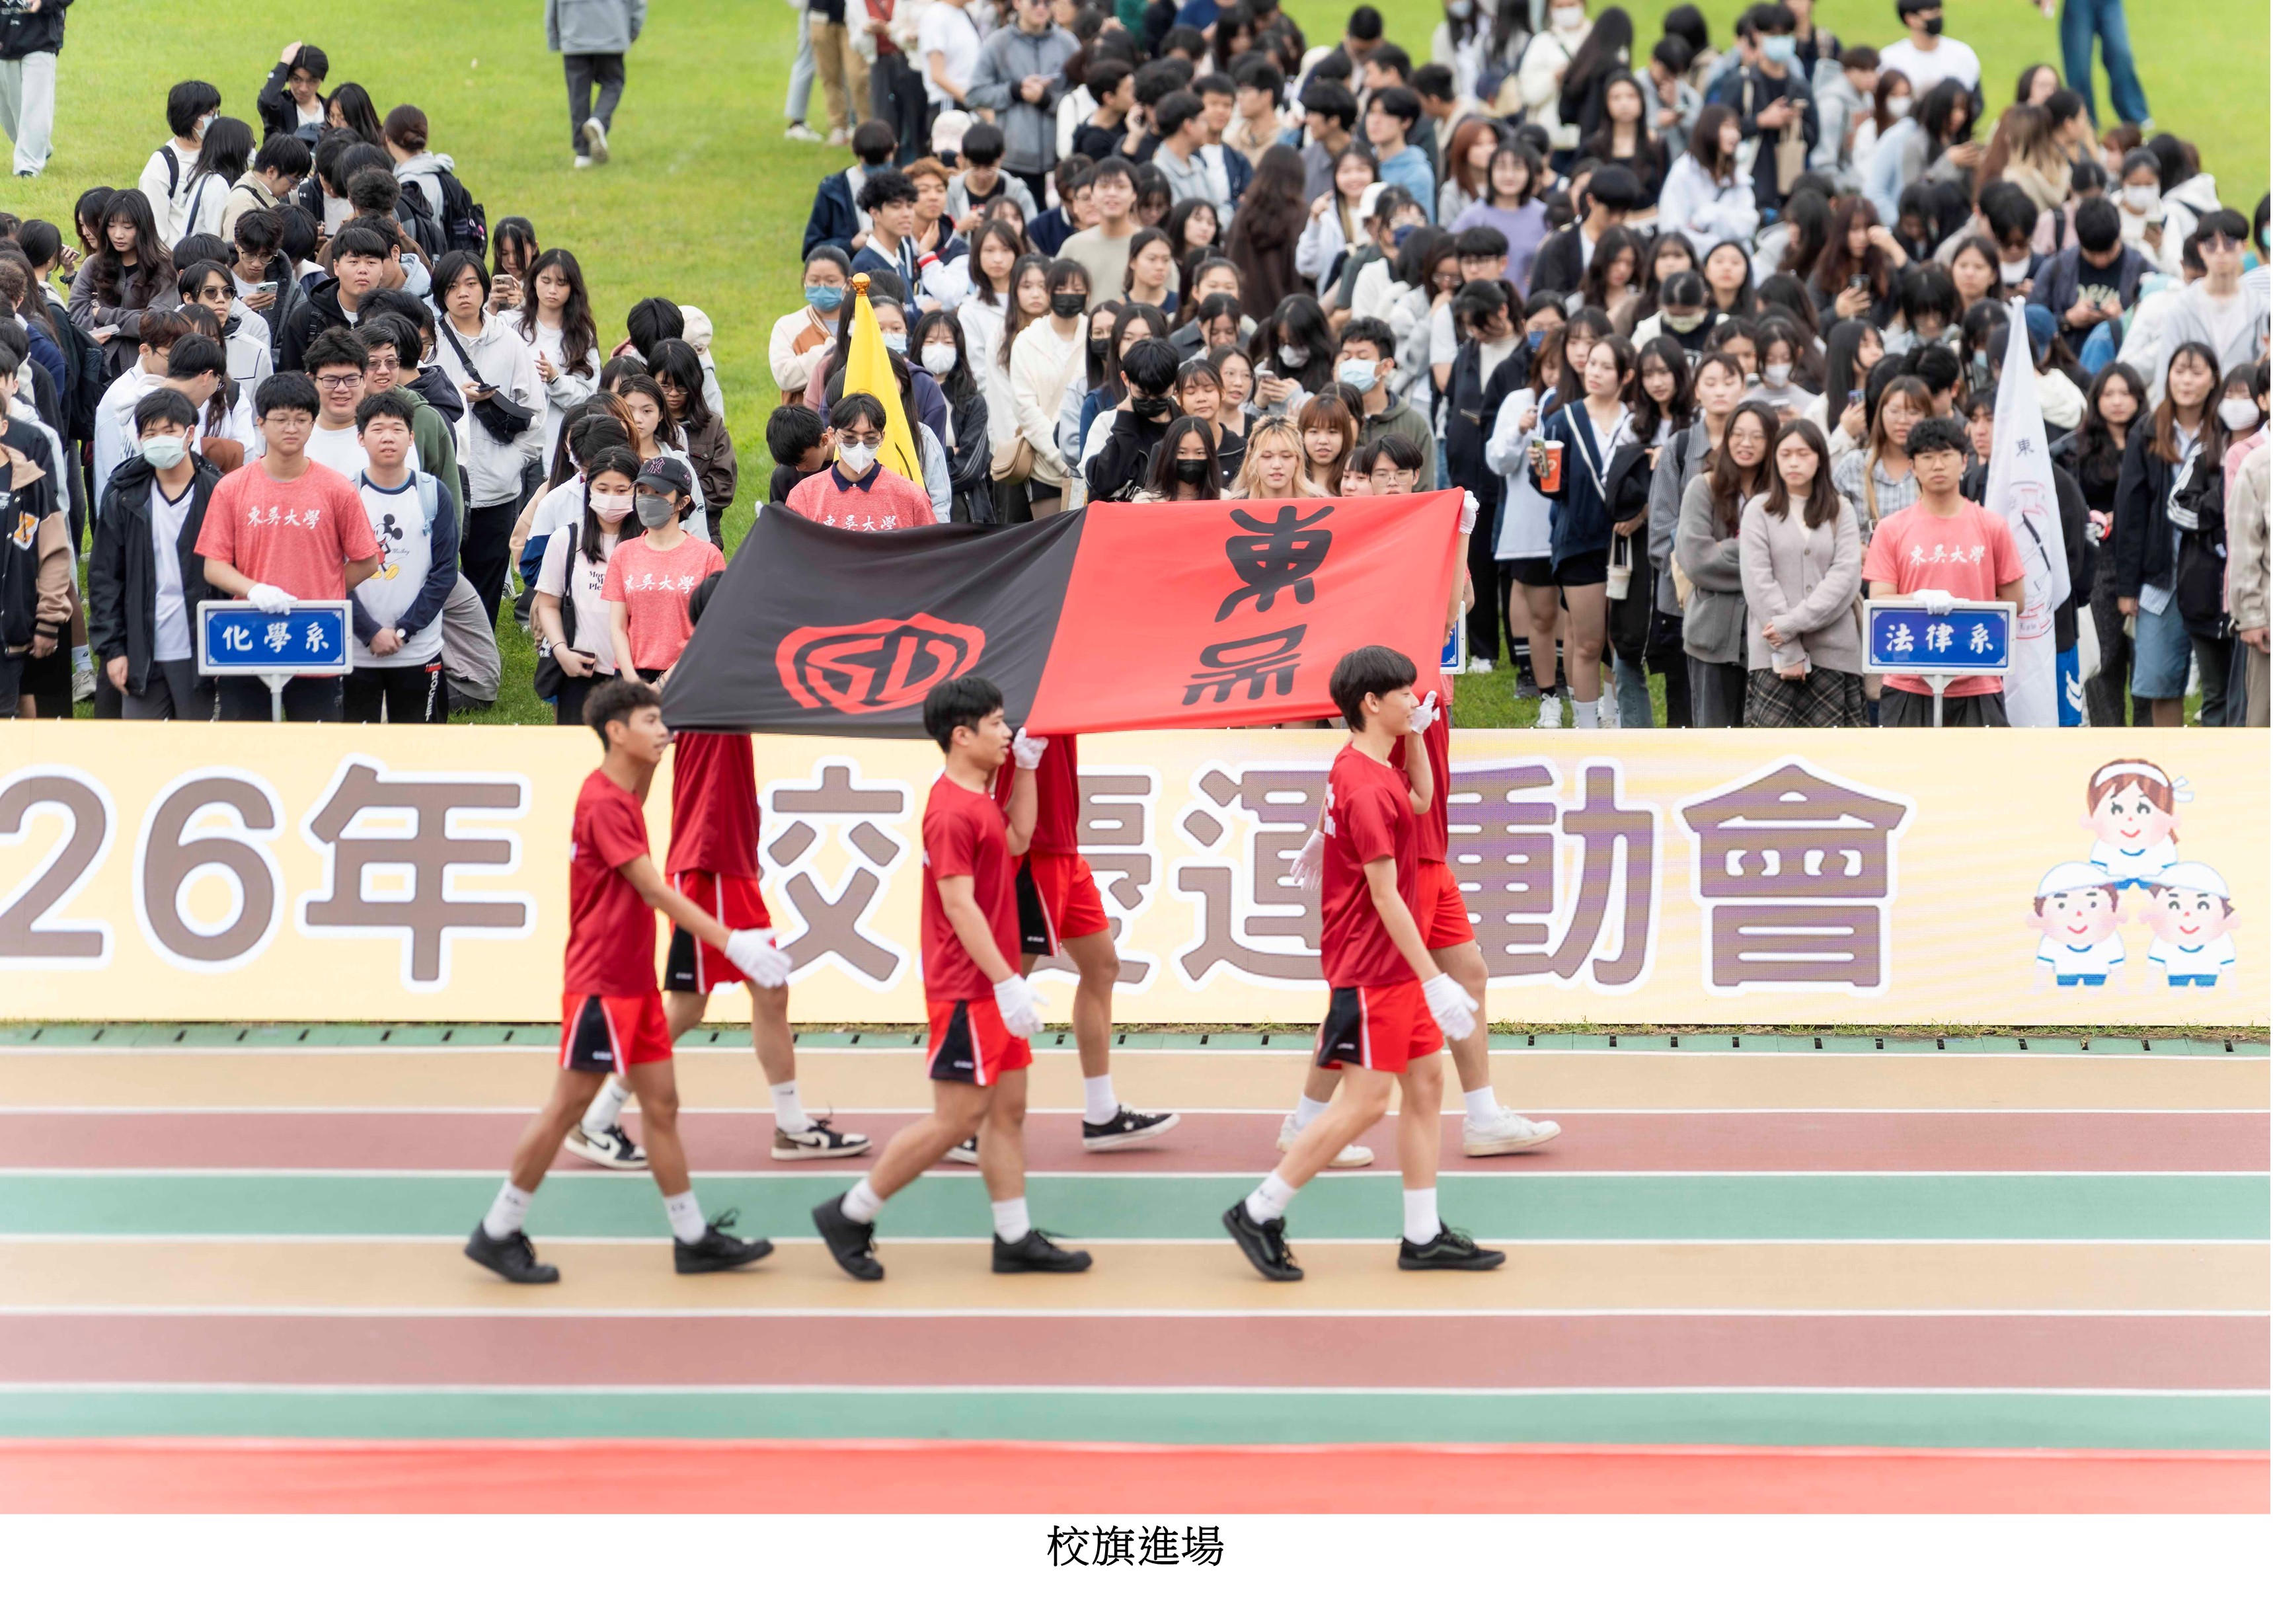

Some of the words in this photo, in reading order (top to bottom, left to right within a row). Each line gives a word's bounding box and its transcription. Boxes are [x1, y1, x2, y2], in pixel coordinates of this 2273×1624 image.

[2016, 437, 2034, 457] 東
[247, 505, 321, 529] 東吳大學
[1909, 543, 1986, 567] 東吳大學
[1181, 506, 1335, 706] 東吳
[221, 621, 330, 654] 化學系
[1885, 623, 1994, 654] 法律系
